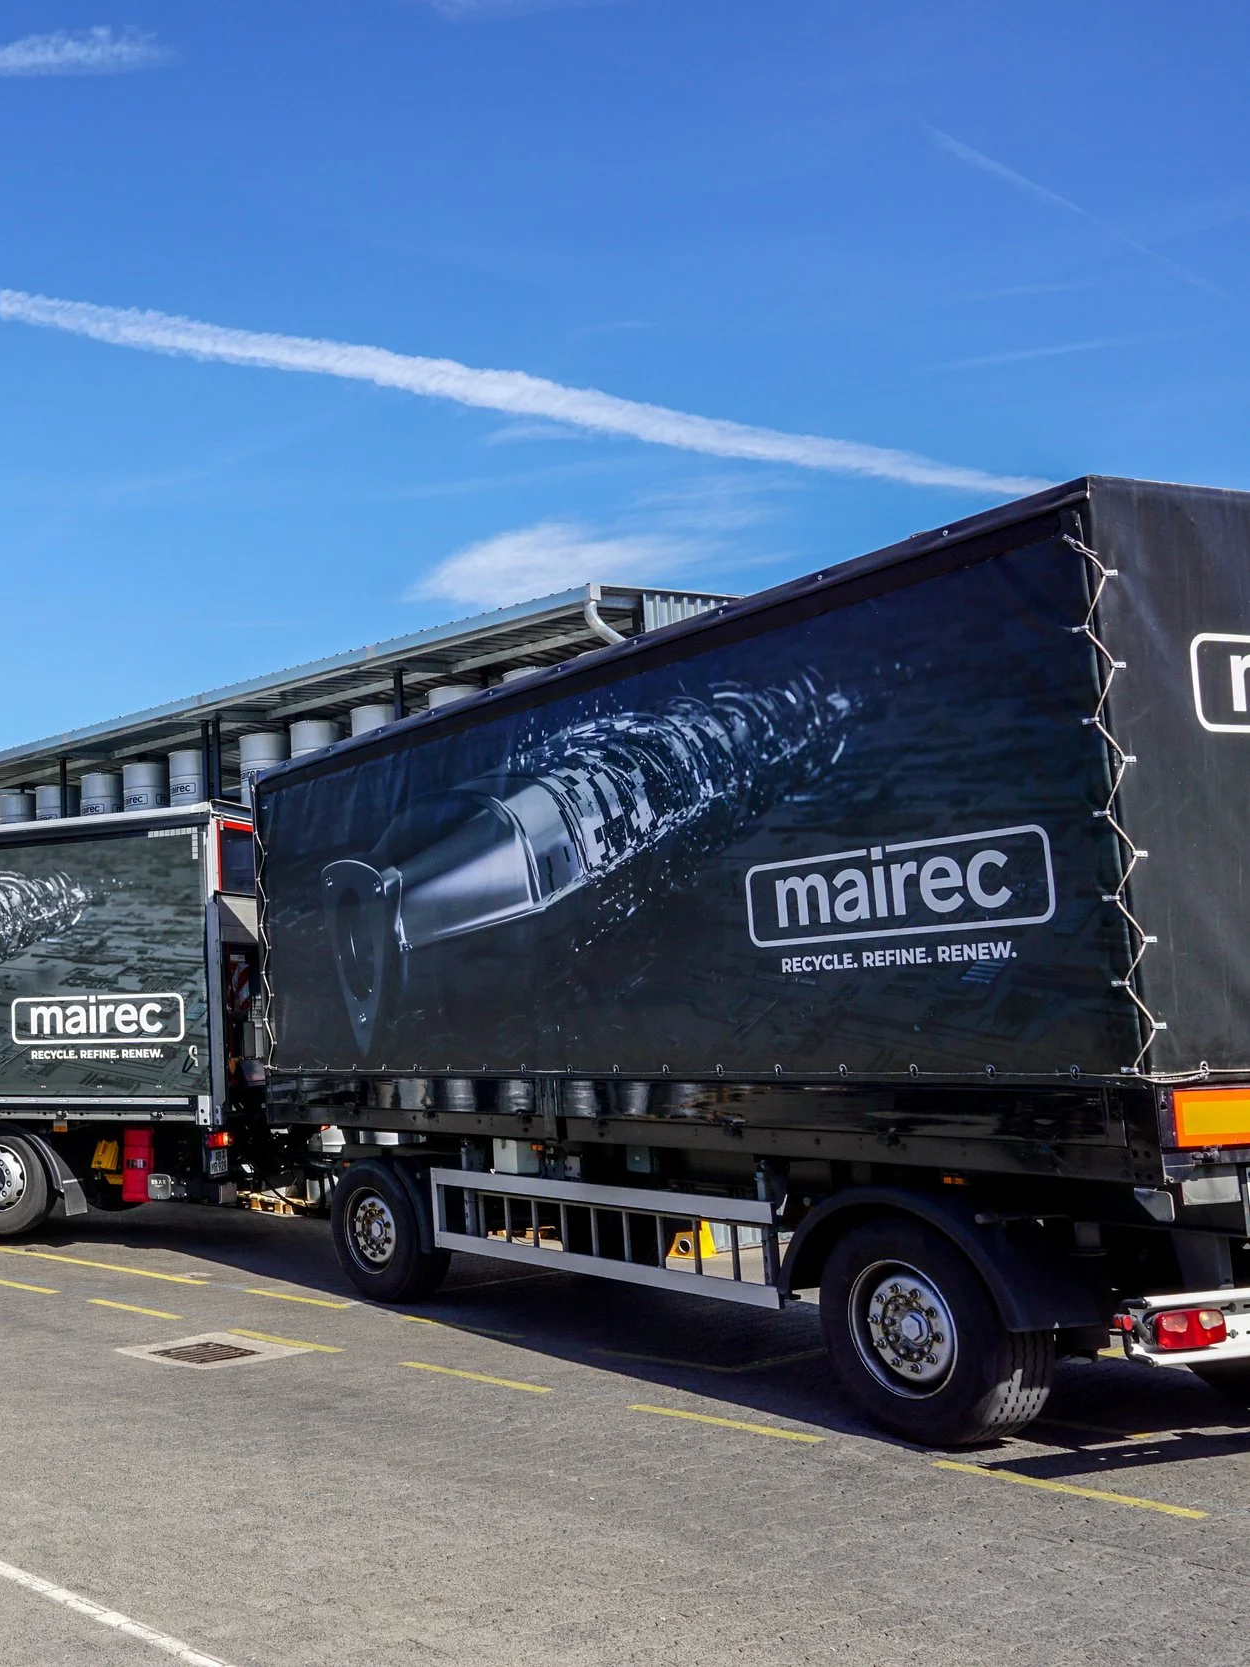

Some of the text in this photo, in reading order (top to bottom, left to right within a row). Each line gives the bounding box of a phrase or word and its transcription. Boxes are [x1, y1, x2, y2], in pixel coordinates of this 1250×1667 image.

[775, 846, 1013, 928] mairec
[781, 941, 1017, 973] RECYCLE. REFINE. RENEW.
[30, 995, 164, 1035] mairec
[31, 1049, 164, 1060] RECYCLE. REFINE. RENEW.
